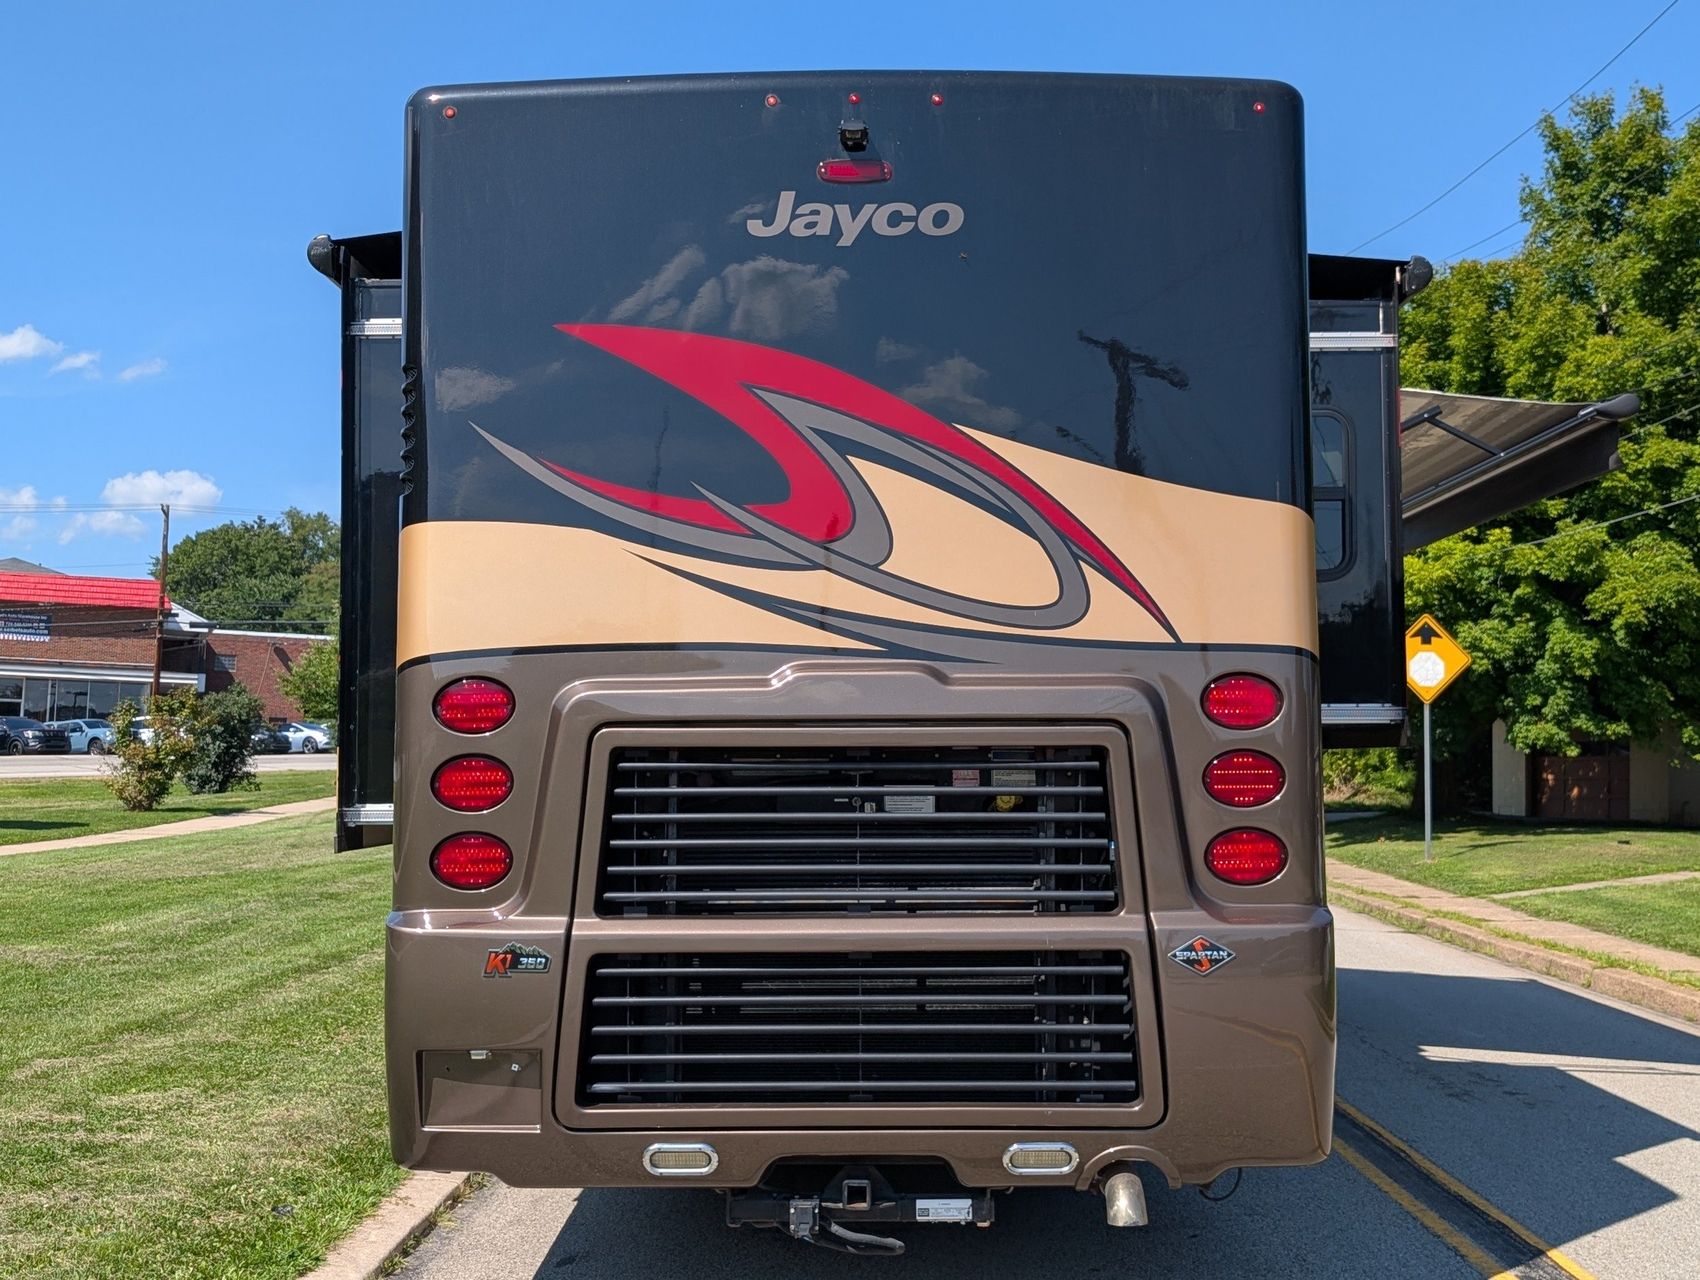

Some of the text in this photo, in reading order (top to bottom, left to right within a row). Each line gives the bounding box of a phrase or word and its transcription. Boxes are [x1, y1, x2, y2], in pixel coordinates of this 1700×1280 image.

[746, 190, 965, 247] Jayco
[485, 952, 546, 976] K1 350
[1175, 950, 1228, 960] SPARTAN
